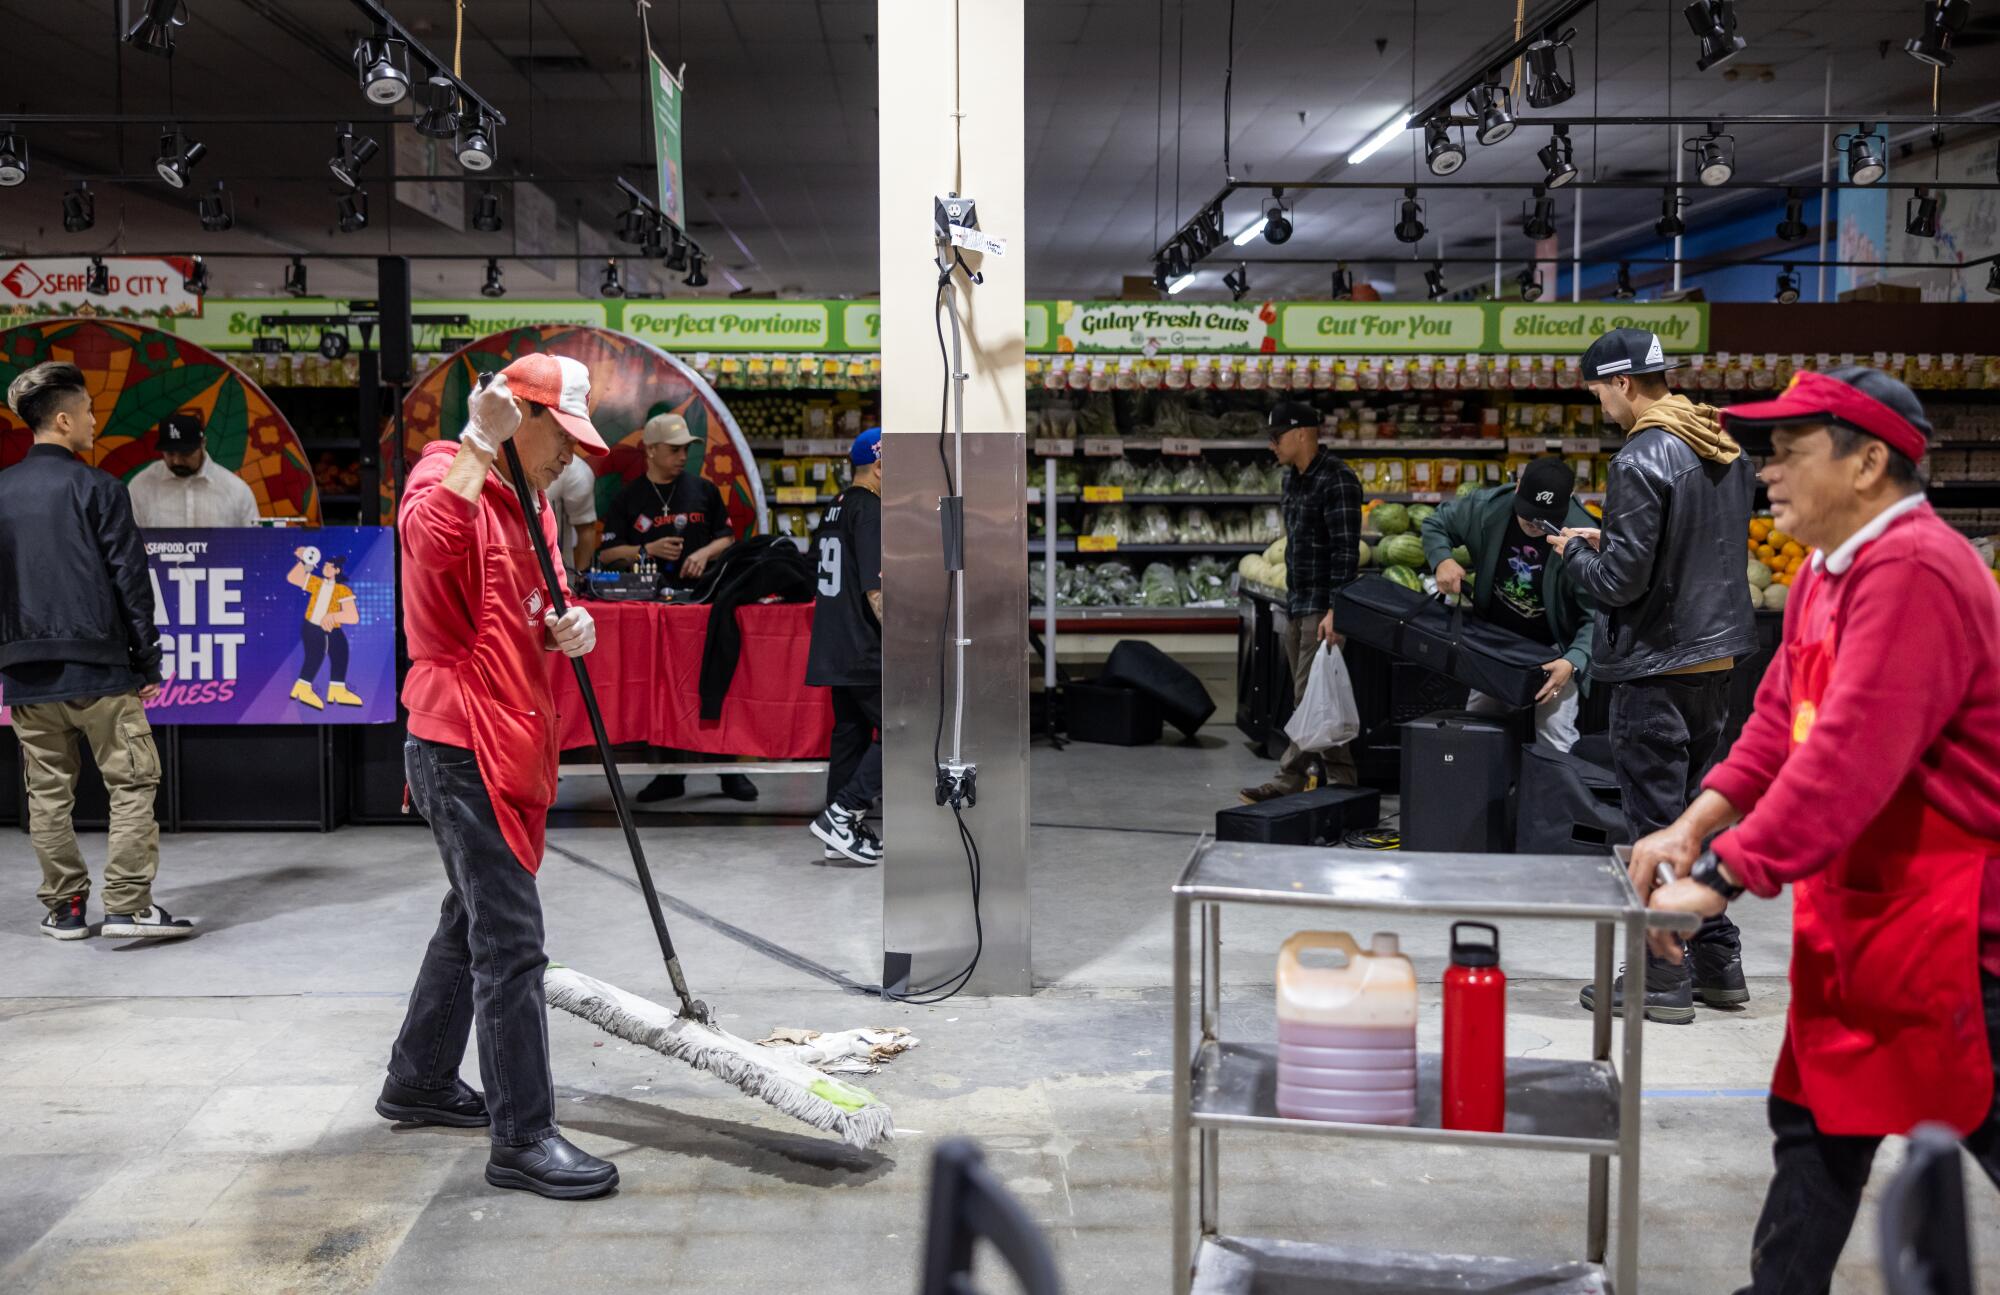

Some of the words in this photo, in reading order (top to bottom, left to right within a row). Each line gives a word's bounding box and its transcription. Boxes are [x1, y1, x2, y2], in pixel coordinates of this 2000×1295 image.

[43, 273, 120, 295] SEAFD
[126, 275, 168, 296] CITY
[630, 312, 717, 337] Perfect
[719, 313, 821, 334] Portions
[1081, 312, 1140, 335] Gulay
[1142, 311, 1202, 329] Fresh
[1205, 312, 1249, 332] Cuts
[1316, 315, 1358, 336] Cut
[1360, 314, 1406, 336] For
[1407, 314, 1453, 340] You
[1513, 314, 1586, 336] Sliced
[1588, 316, 1606, 336] &
[146, 542, 184, 555] SEAFOOD
[186, 542, 208, 554] CITY
[148, 568, 245, 625] ATE
[153, 633, 246, 680] GHT
